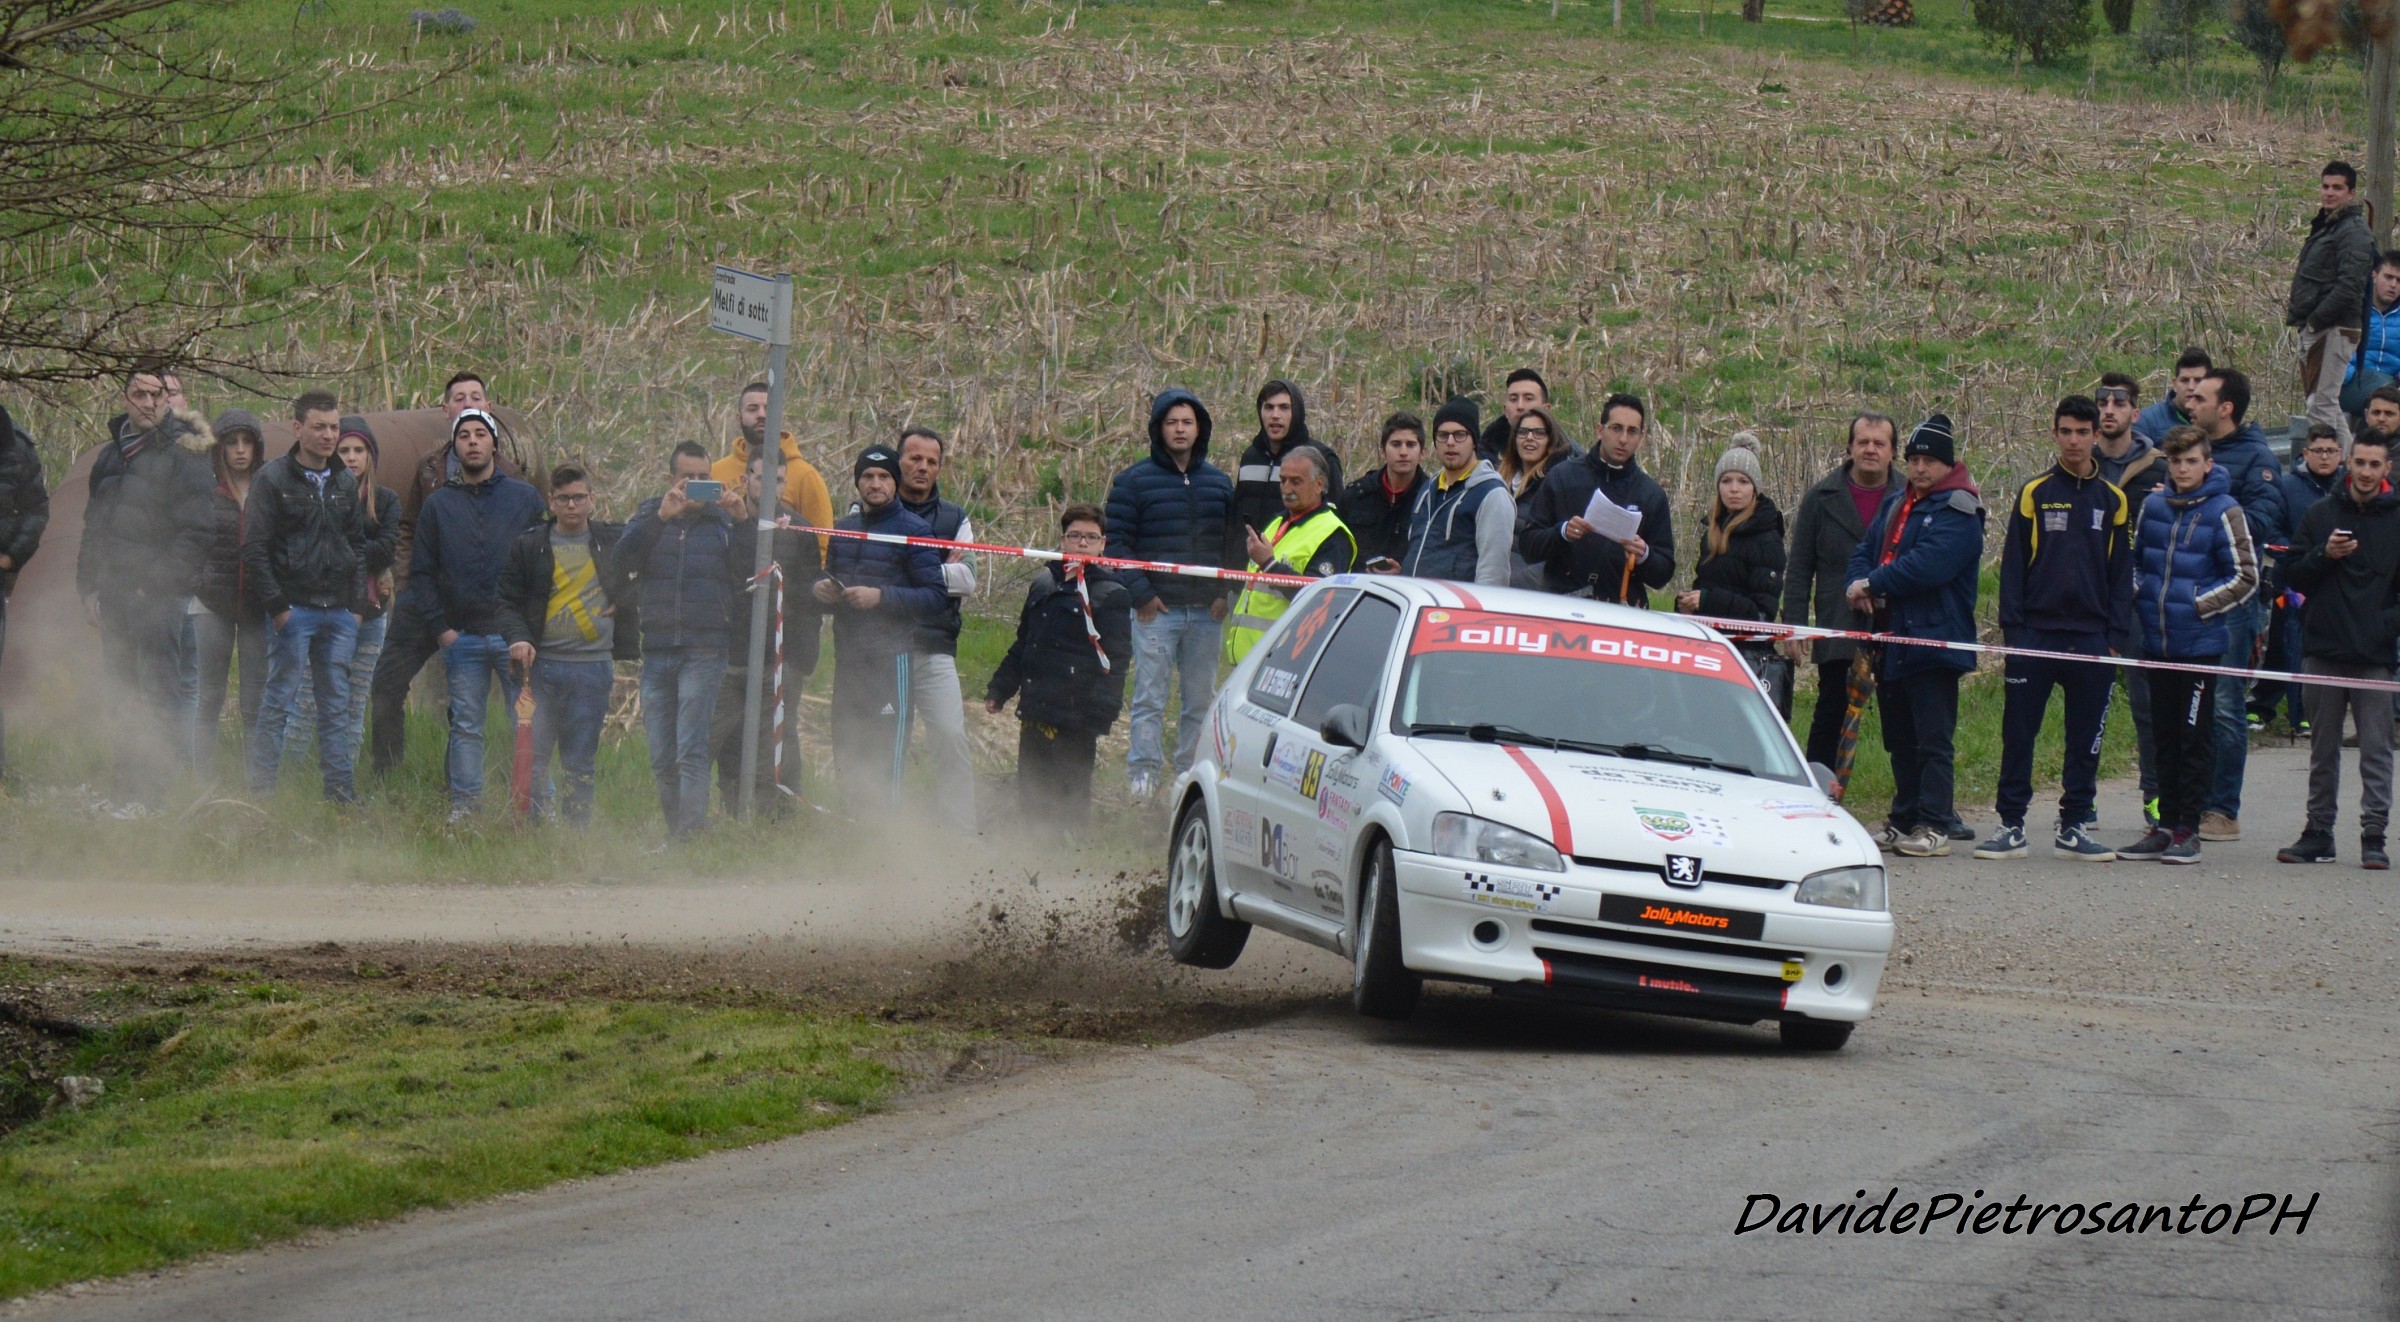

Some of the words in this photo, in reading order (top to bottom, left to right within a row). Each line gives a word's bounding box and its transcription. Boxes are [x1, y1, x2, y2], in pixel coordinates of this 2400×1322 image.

[714, 288, 735, 313] Melfi
[738, 296, 745, 316] di
[1431, 624, 1722, 672] JollyMotors
[1303, 751, 1325, 798] 35
[1635, 774, 1722, 793] Tony
[1640, 905, 1729, 928] JollyMotors
